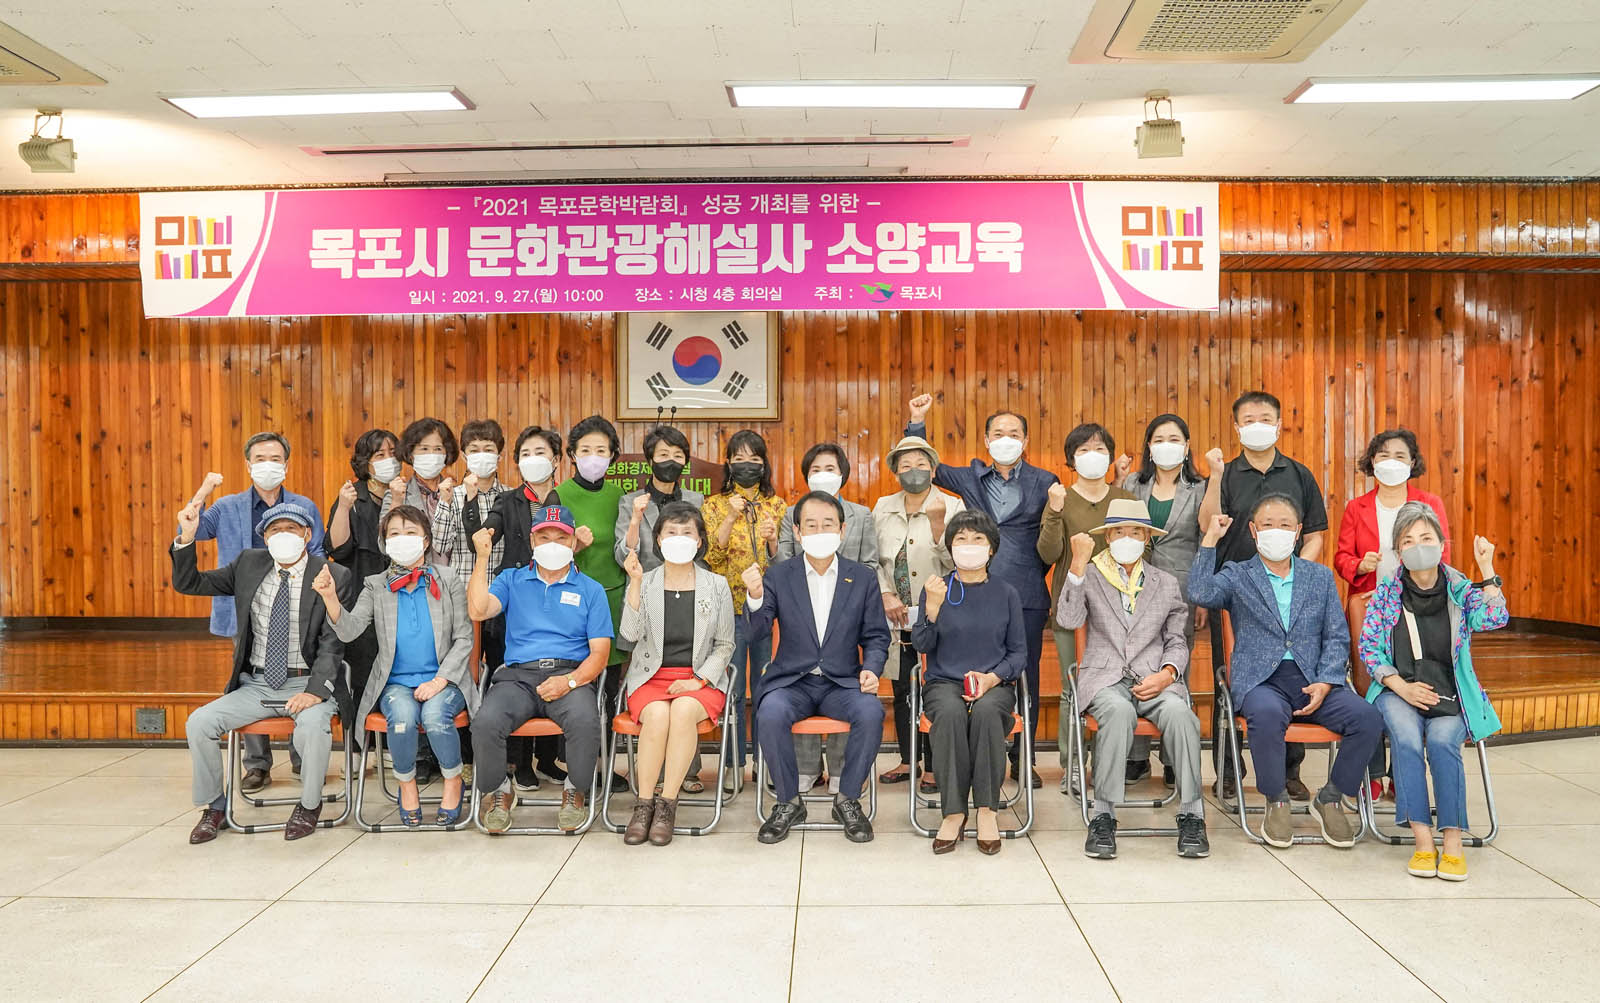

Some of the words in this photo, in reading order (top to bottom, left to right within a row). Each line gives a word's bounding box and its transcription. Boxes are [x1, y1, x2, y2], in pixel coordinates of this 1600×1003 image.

[701, 193, 742, 215] 성공
[750, 193, 811, 215] 개최를
[818, 193, 860, 215] 위한
[308, 227, 449, 279] 목포시
[466, 223, 813, 278] 문화관광해설사
[826, 221, 1025, 276] 소양교육
[408, 290, 436, 306] 일시
[452, 290, 490, 305] 2021.
[494, 290, 509, 304] 9.
[512, 287, 559, 304] 27.(월)
[564, 288, 604, 303] 10:00
[635, 287, 663, 303] 장소
[679, 287, 708, 303] 시청
[712, 287, 736, 303] 4층
[740, 286, 782, 302] 회의실
[814, 286, 842, 302] 주최
[899, 285, 943, 301] 목포시
[545, 507, 561, 521] H
